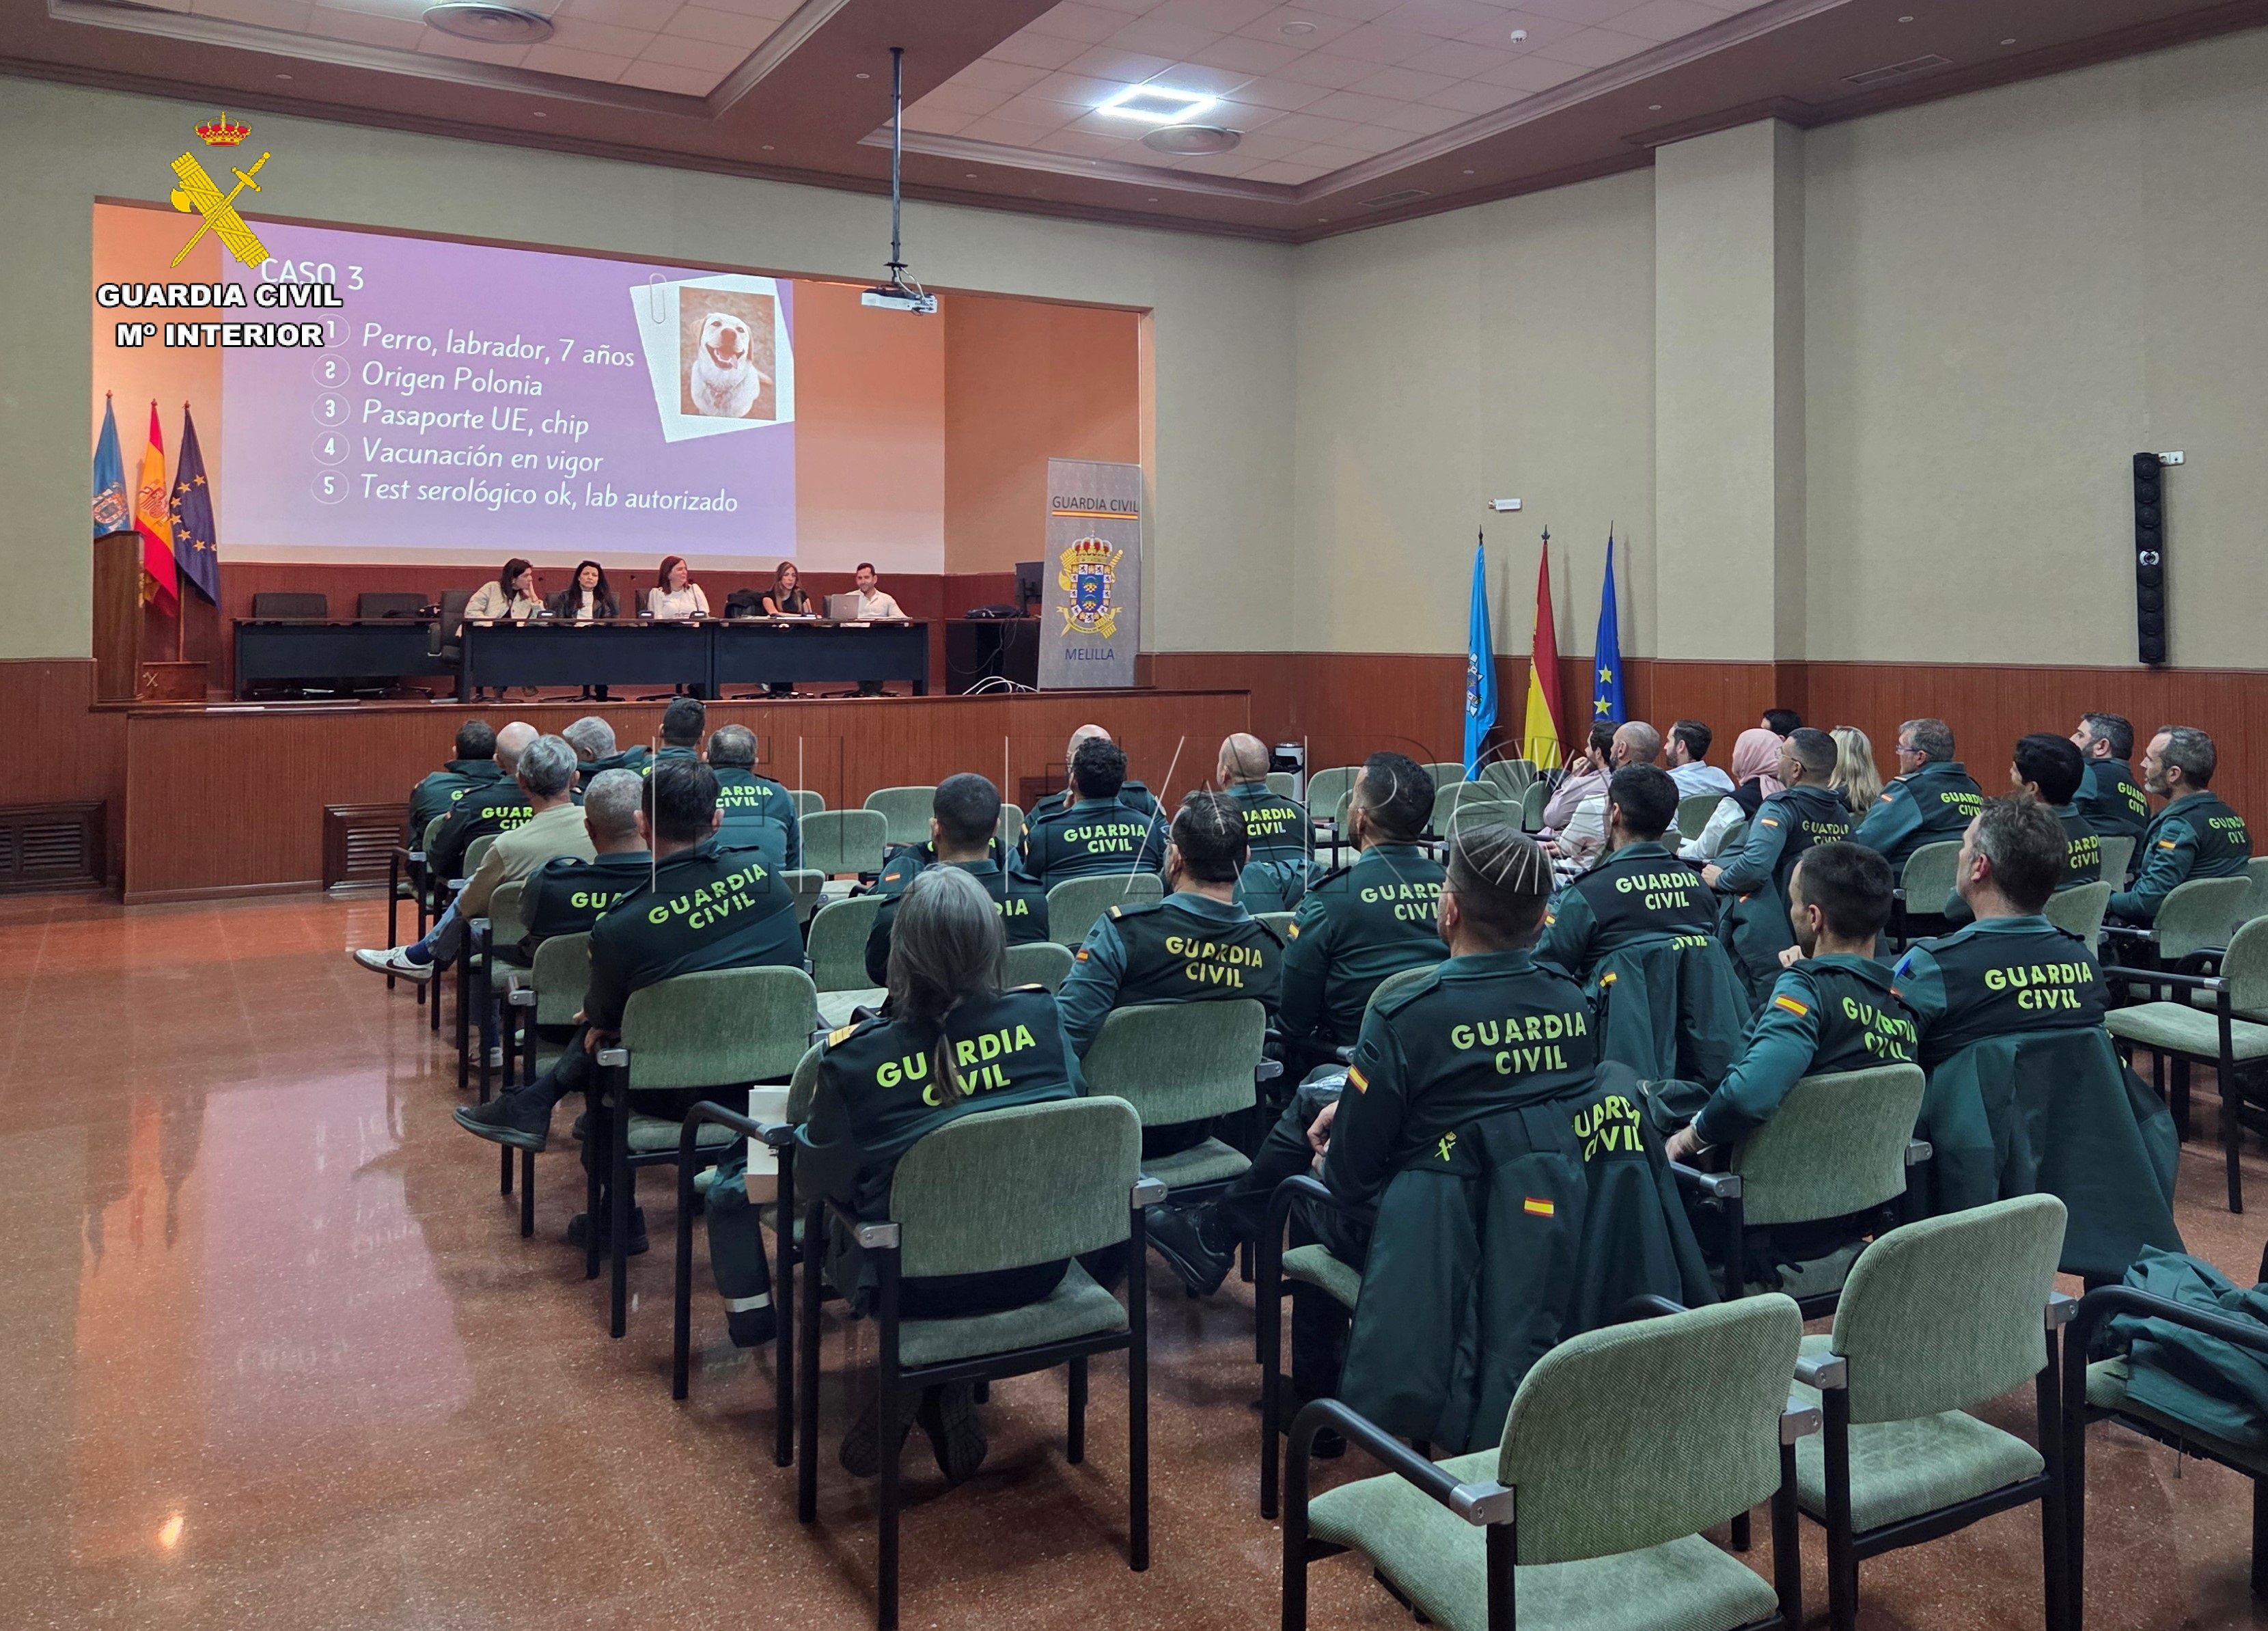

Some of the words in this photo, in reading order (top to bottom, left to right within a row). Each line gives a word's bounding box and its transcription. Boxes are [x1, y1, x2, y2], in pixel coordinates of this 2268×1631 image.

[262, 258, 336, 284] CASO
[347, 265, 364, 290] 3
[327, 320, 335, 338] 1
[363, 323, 437, 357] Perro,
[446, 329, 550, 365] labrador,
[559, 338, 575, 361] 7
[583, 344, 634, 367] años
[325, 361, 335, 379] 2
[363, 361, 445, 396] Origen
[454, 366, 542, 396] Polonia
[325, 399, 335, 417] 3
[363, 398, 484, 435] Pasaporte
[491, 406, 534, 437] UE,
[542, 409, 589, 443] chip
[324, 437, 335, 455] 4
[363, 436, 503, 467] Vacunación
[511, 453, 538, 469] en
[547, 450, 603, 478] vigor
[324, 476, 335, 495] 5
[361, 474, 411, 499] Test
[417, 477, 536, 511] serológico
[544, 480, 577, 510] ok,
[585, 482, 618, 508] lab
[625, 488, 738, 512] autorizado
[1052, 495, 1107, 511] GUARDIA
[1110, 499, 1139, 512] CIVIL
[1065, 648, 1115, 661] MELILLA
[715, 797, 759, 808] CIVIL
[721, 786, 773, 797] ARDIA
[482, 807, 533, 819] GUAR
[1064, 823, 1146, 842] GUARDIA
[1247, 821, 1286, 836] CIVIL
[1088, 838, 1133, 853] CIVIL
[2070, 851, 2099, 868] CIVIL
[648, 864, 768, 924] GUARDIA
[1360, 883, 1444, 903] GUARD
[1615, 873, 1700, 893] GUARDIA
[689, 891, 756, 929] CIVIL
[1394, 902, 1438, 920] CIVI
[1645, 891, 1690, 910] CIVIL
[1165, 936, 1262, 968] GUARDIA
[1186, 961, 1244, 988] CIVIL
[1984, 961, 2093, 990] GUARDIA
[2018, 989, 2082, 1010] CIVIL
[1451, 1011, 1587, 1050] GUARDIA
[876, 1024, 1036, 1088] GURDIA
[1495, 1045, 1568, 1075] CIVIL
[922, 1063, 1011, 1106] CVIL
